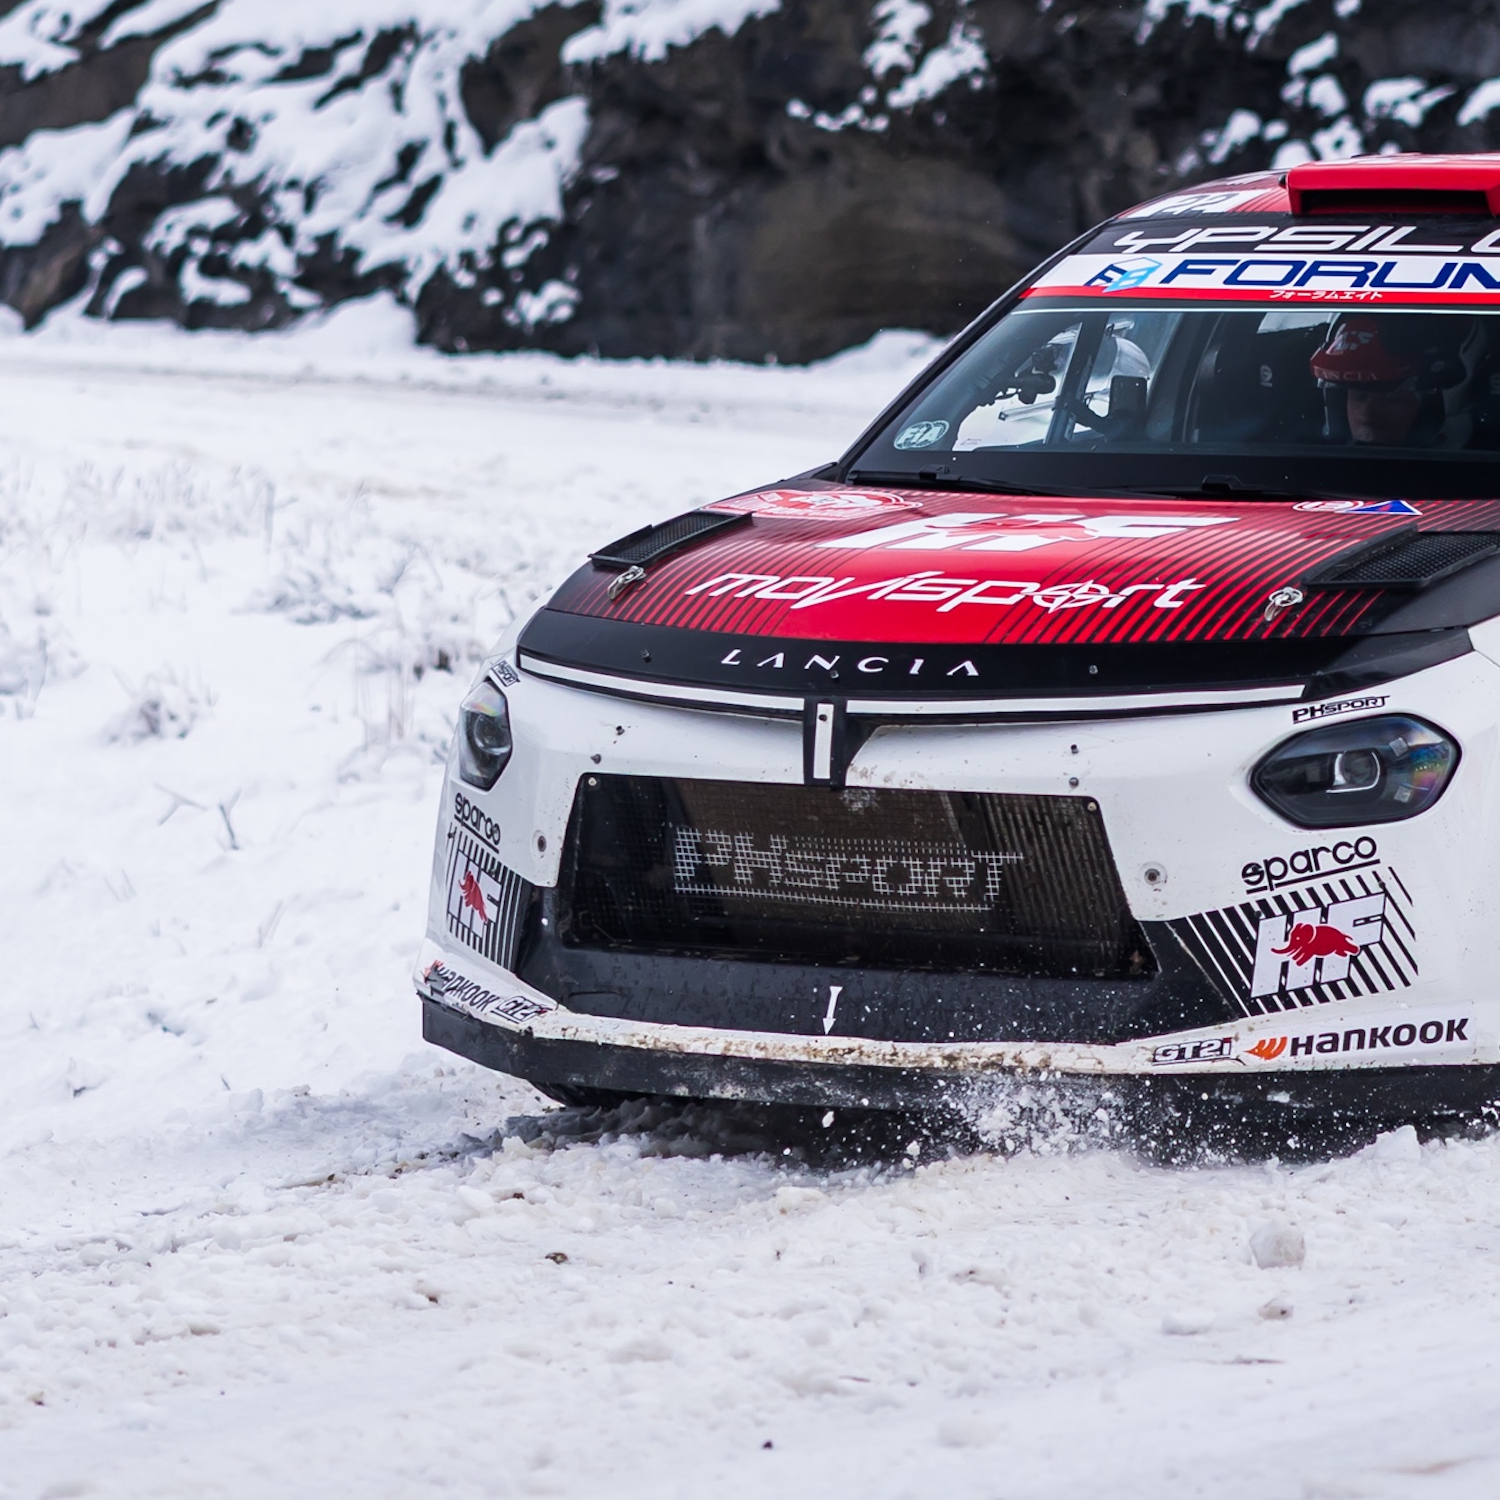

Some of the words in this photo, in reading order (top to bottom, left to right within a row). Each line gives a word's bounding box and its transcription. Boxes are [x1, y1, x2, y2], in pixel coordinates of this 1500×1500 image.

[899, 426, 940, 446] FIA
[720, 648, 980, 678] LANCIA
[1291, 695, 1391, 725] PHSPORT
[454, 792, 501, 847] sparco
[1241, 835, 1378, 892] sparco
